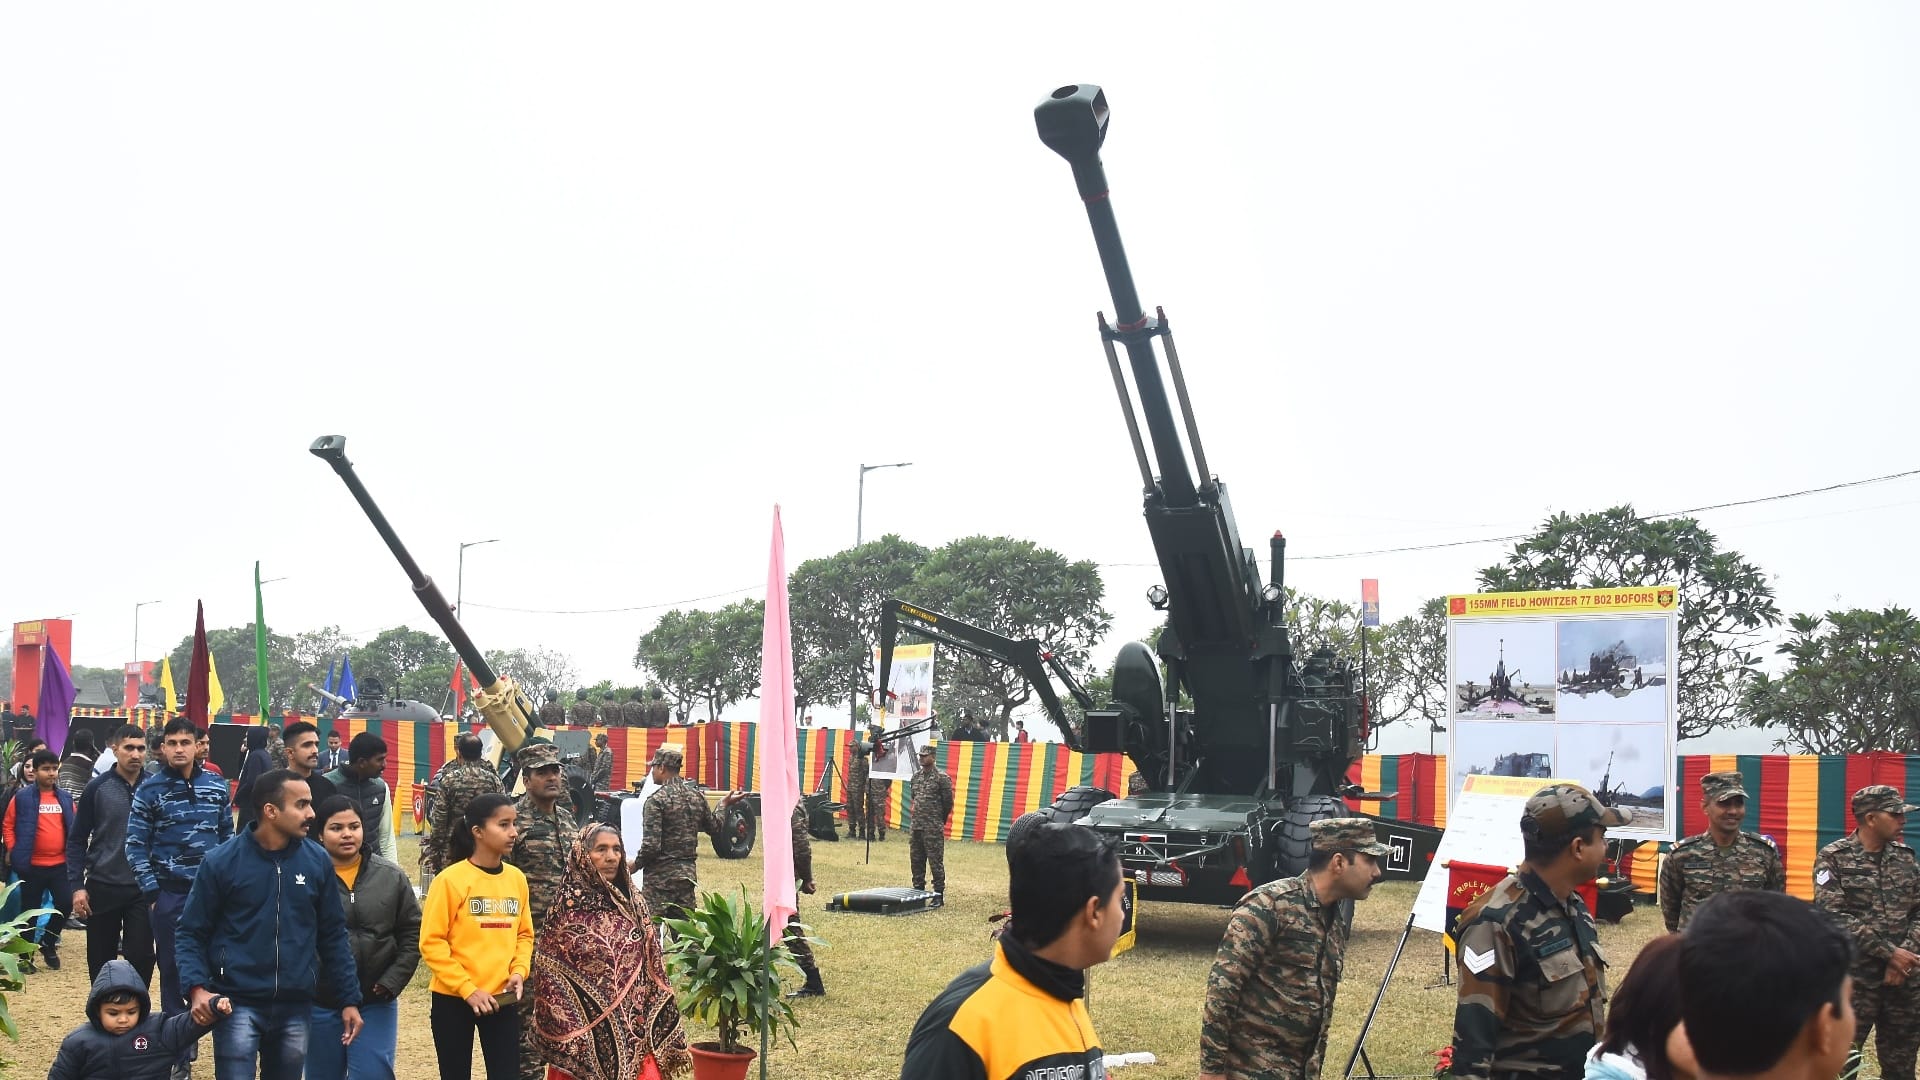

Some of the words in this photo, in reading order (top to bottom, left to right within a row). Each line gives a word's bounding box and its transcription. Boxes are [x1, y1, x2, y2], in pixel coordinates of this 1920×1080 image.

[1469, 598, 1498, 609] 155MM
[1501, 598, 1527, 608] FIELD
[1529, 595, 1578, 607] HOWITZER
[1580, 595, 1591, 605] 77
[1614, 593, 1654, 604] BOFORS
[1453, 880, 1478, 897] TRIPLE
